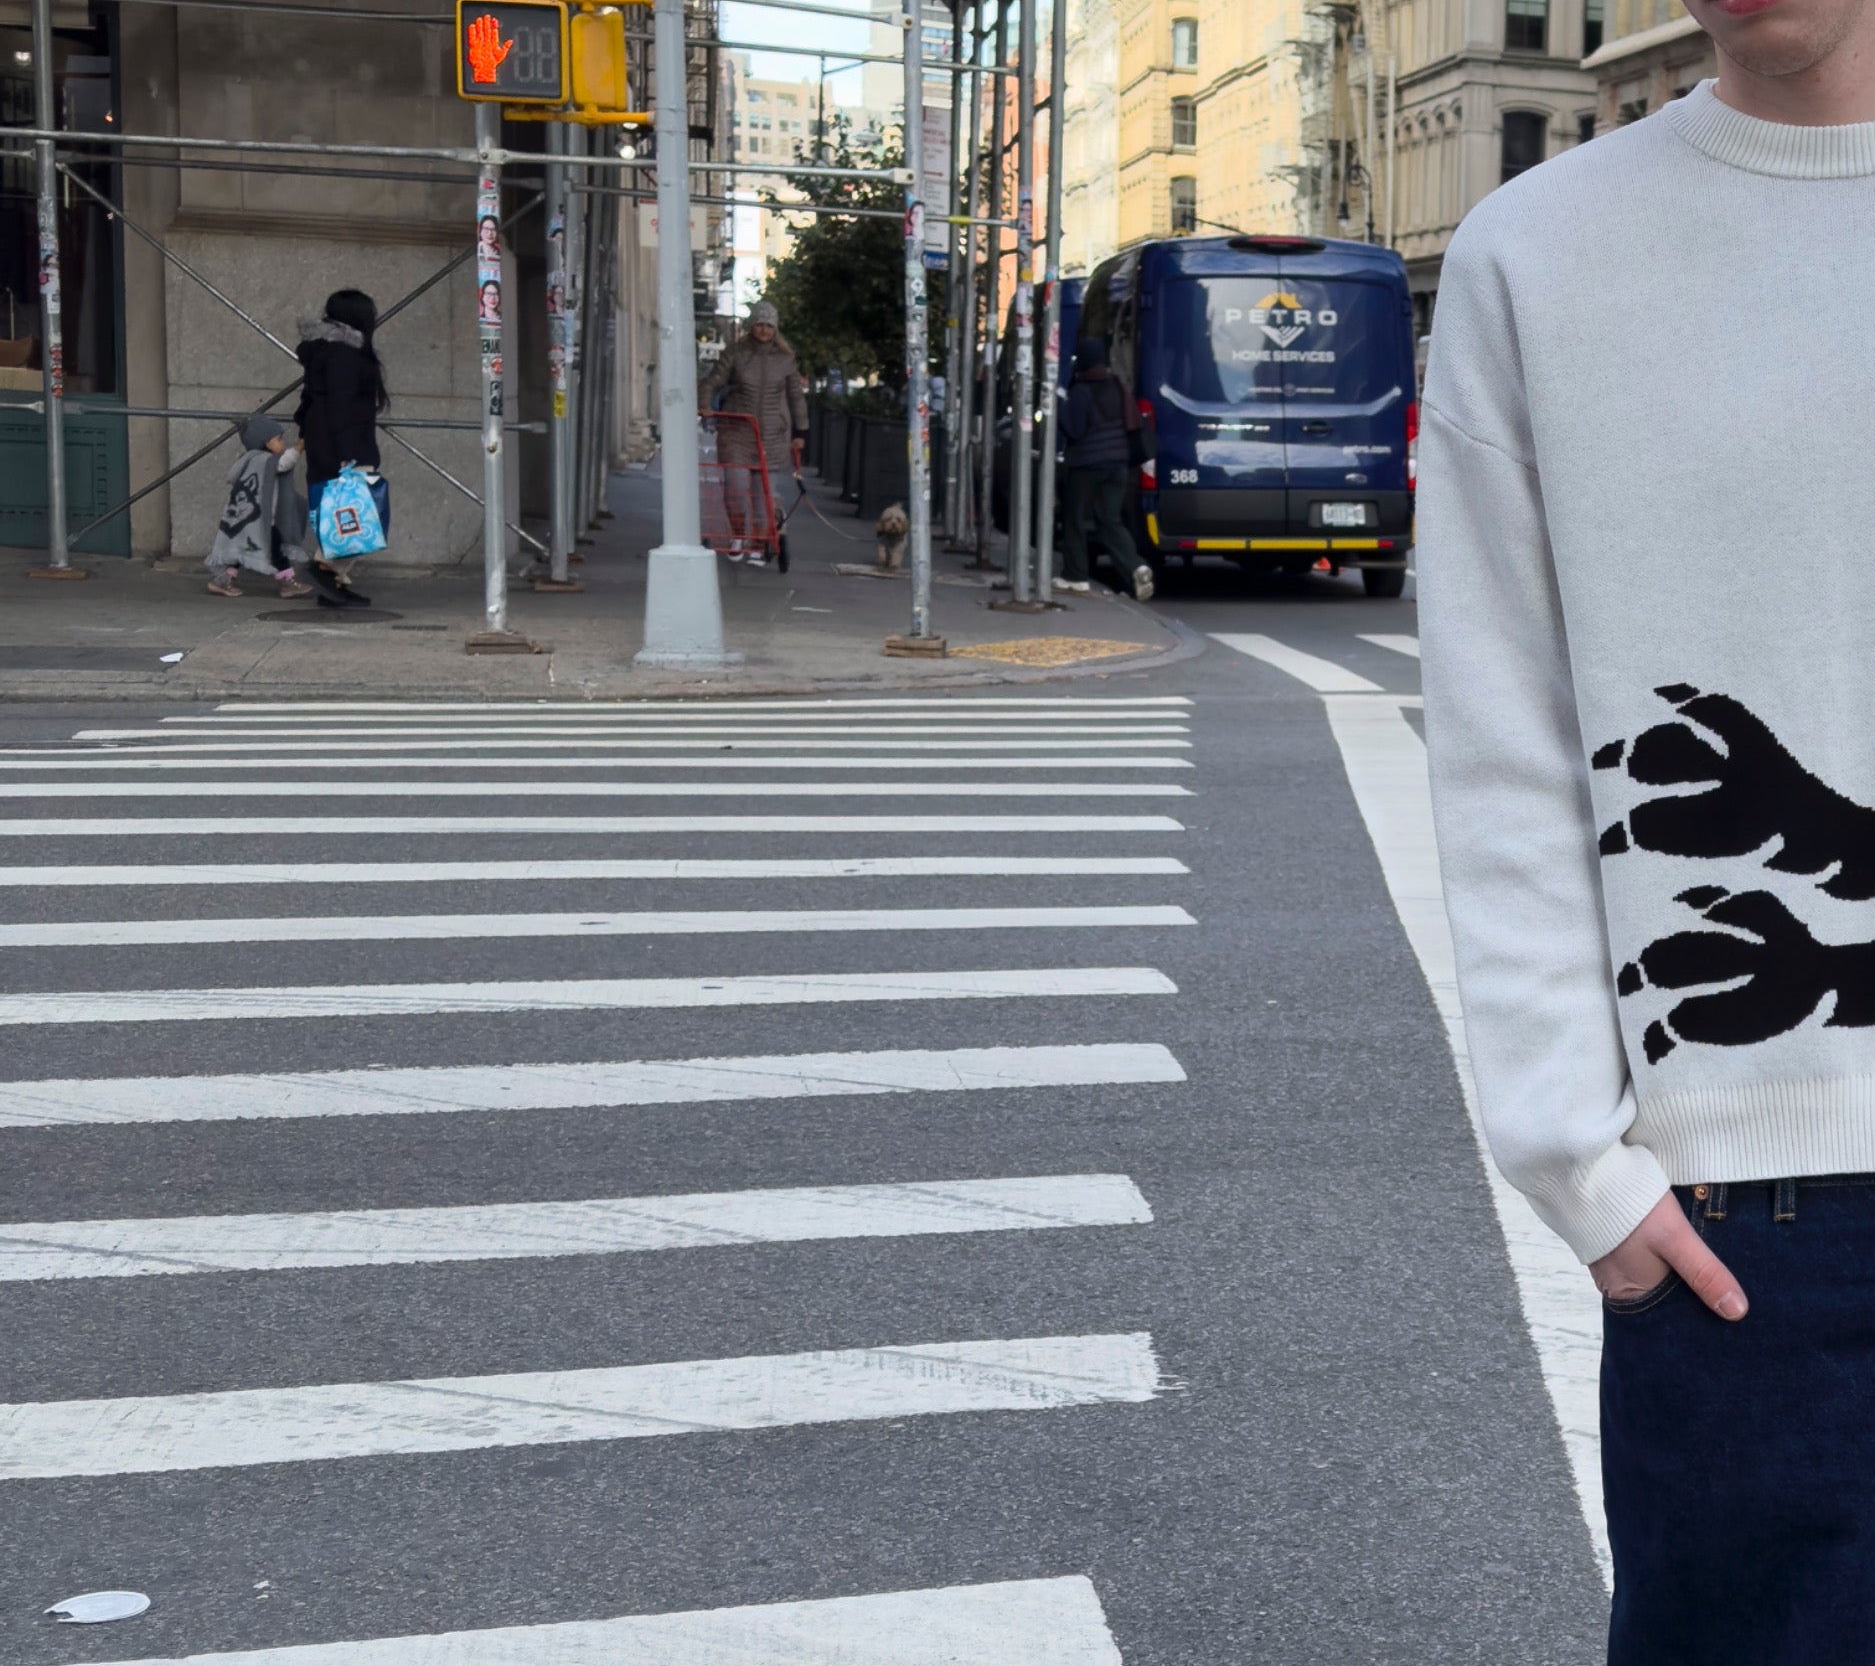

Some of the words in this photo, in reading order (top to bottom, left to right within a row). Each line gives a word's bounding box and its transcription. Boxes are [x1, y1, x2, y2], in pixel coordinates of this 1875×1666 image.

[1225, 308, 1338, 326] PETRO
[1232, 350, 1271, 362] HOME
[1273, 350, 1336, 363] SERVICES
[1170, 468, 1199, 484] 368
